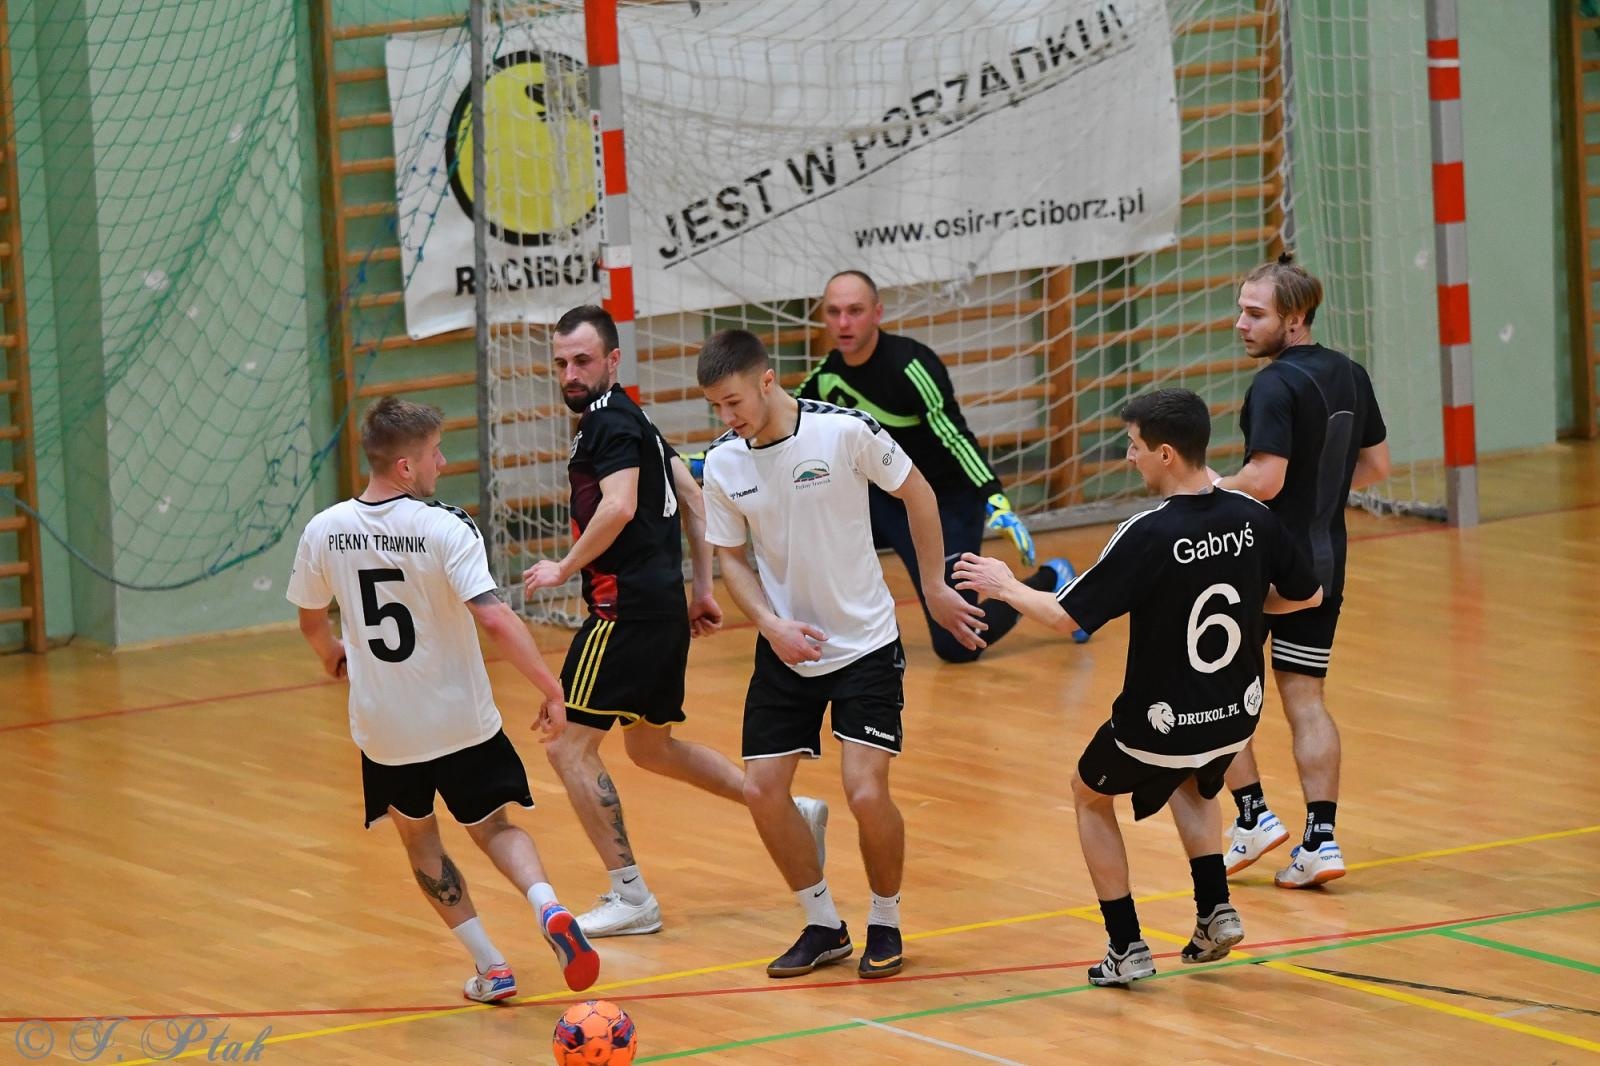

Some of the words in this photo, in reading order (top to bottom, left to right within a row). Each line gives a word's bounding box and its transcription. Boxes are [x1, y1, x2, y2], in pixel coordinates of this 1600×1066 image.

[659, 169, 772, 260] JEST
[787, 145, 836, 197] W
[328, 533, 369, 555] PIĘKNY
[373, 534, 426, 553] TRAWNIK
[1173, 522, 1254, 564] Gabryś
[358, 568, 416, 662] 5
[1187, 583, 1242, 674] 6
[1177, 703, 1240, 726] DRUKOL.PL
